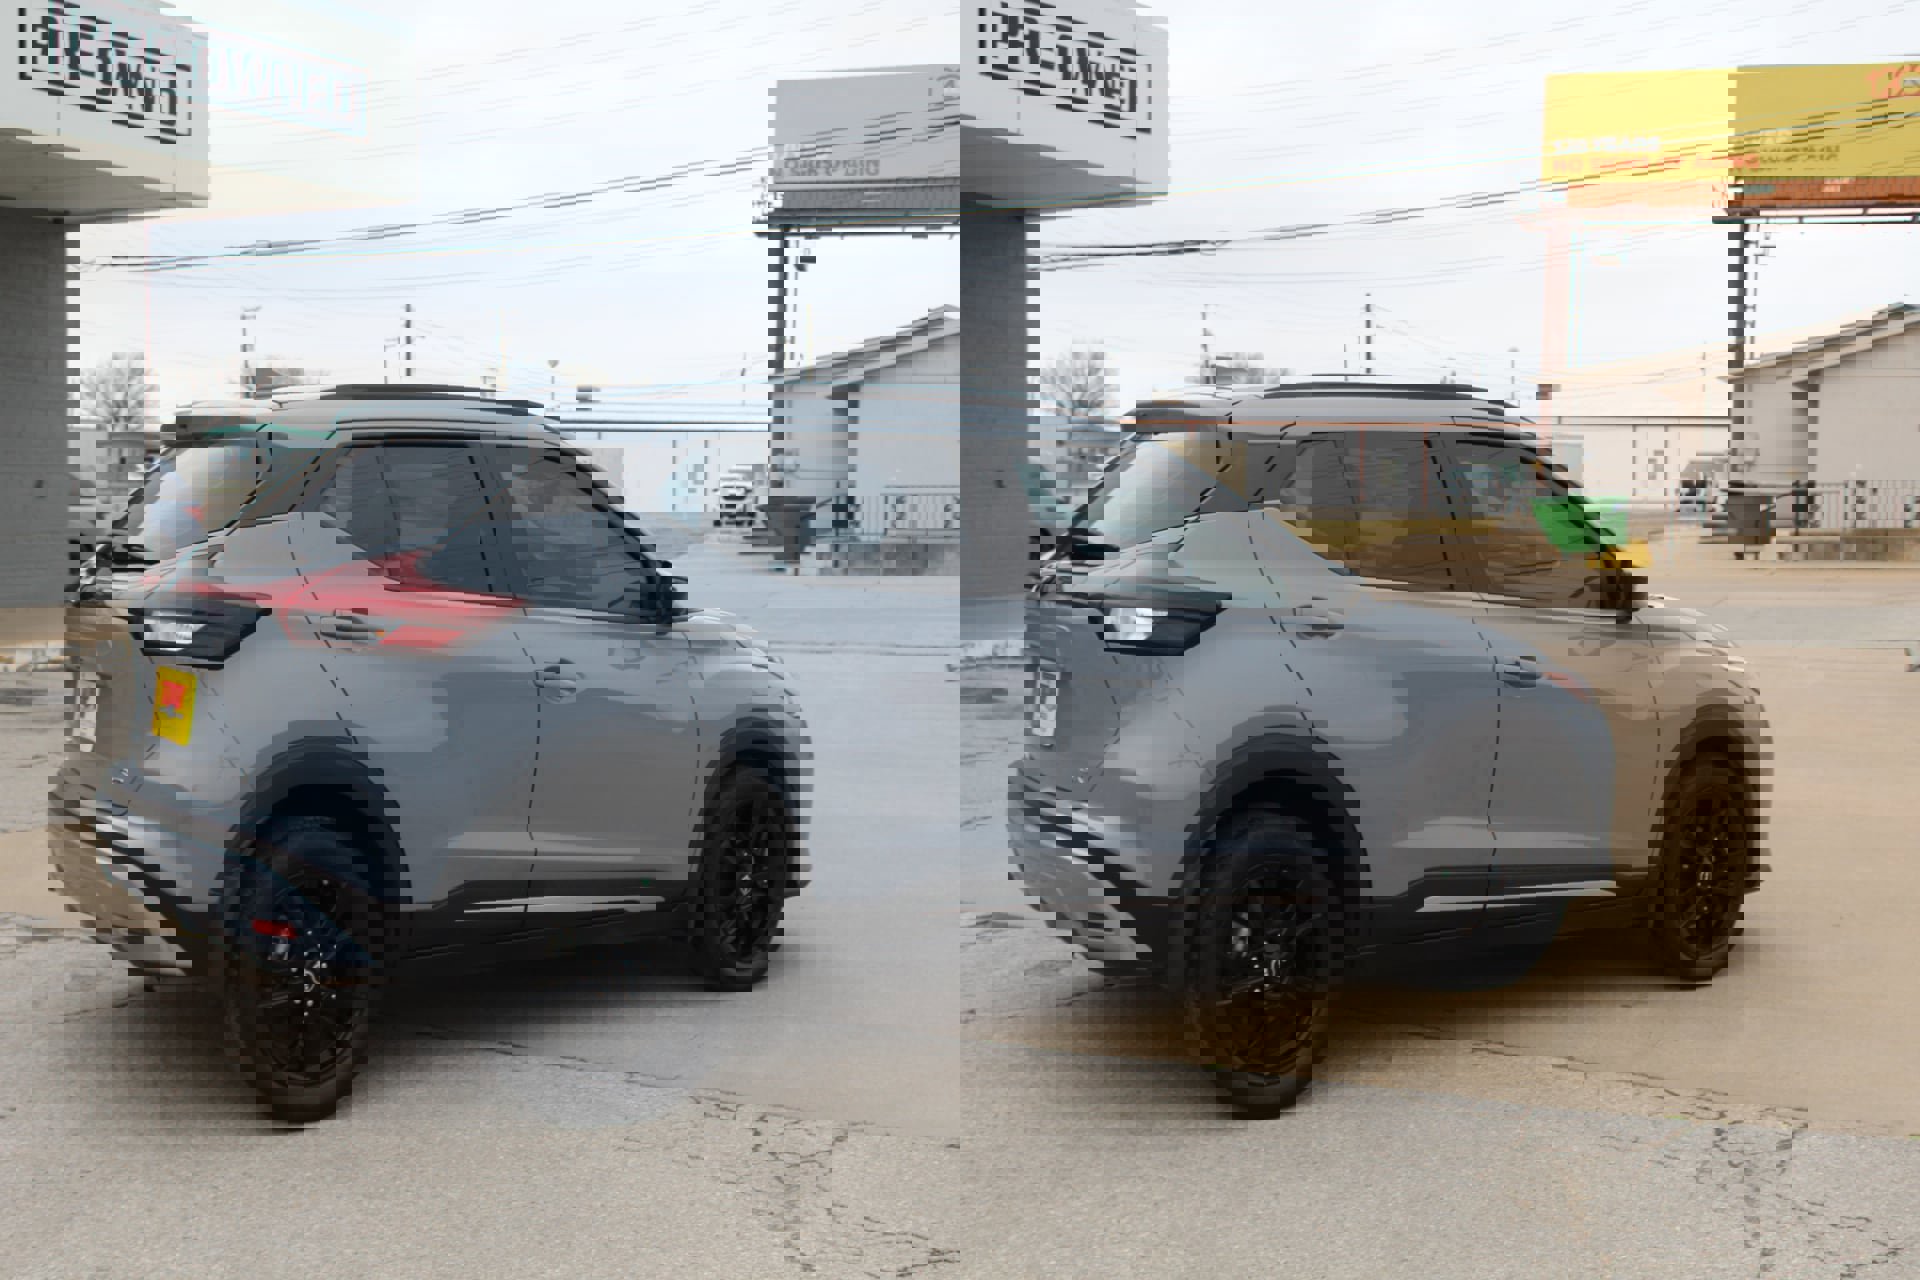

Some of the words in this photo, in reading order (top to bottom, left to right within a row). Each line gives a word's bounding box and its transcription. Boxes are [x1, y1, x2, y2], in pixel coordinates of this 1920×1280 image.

[72, 9, 353, 118] PRE-OWNED
[1553, 157, 1584, 172] NO
[1589, 155, 1650, 171] SIGNS
[1656, 154, 1686, 170] OF
[1692, 152, 1760, 169] AGING
